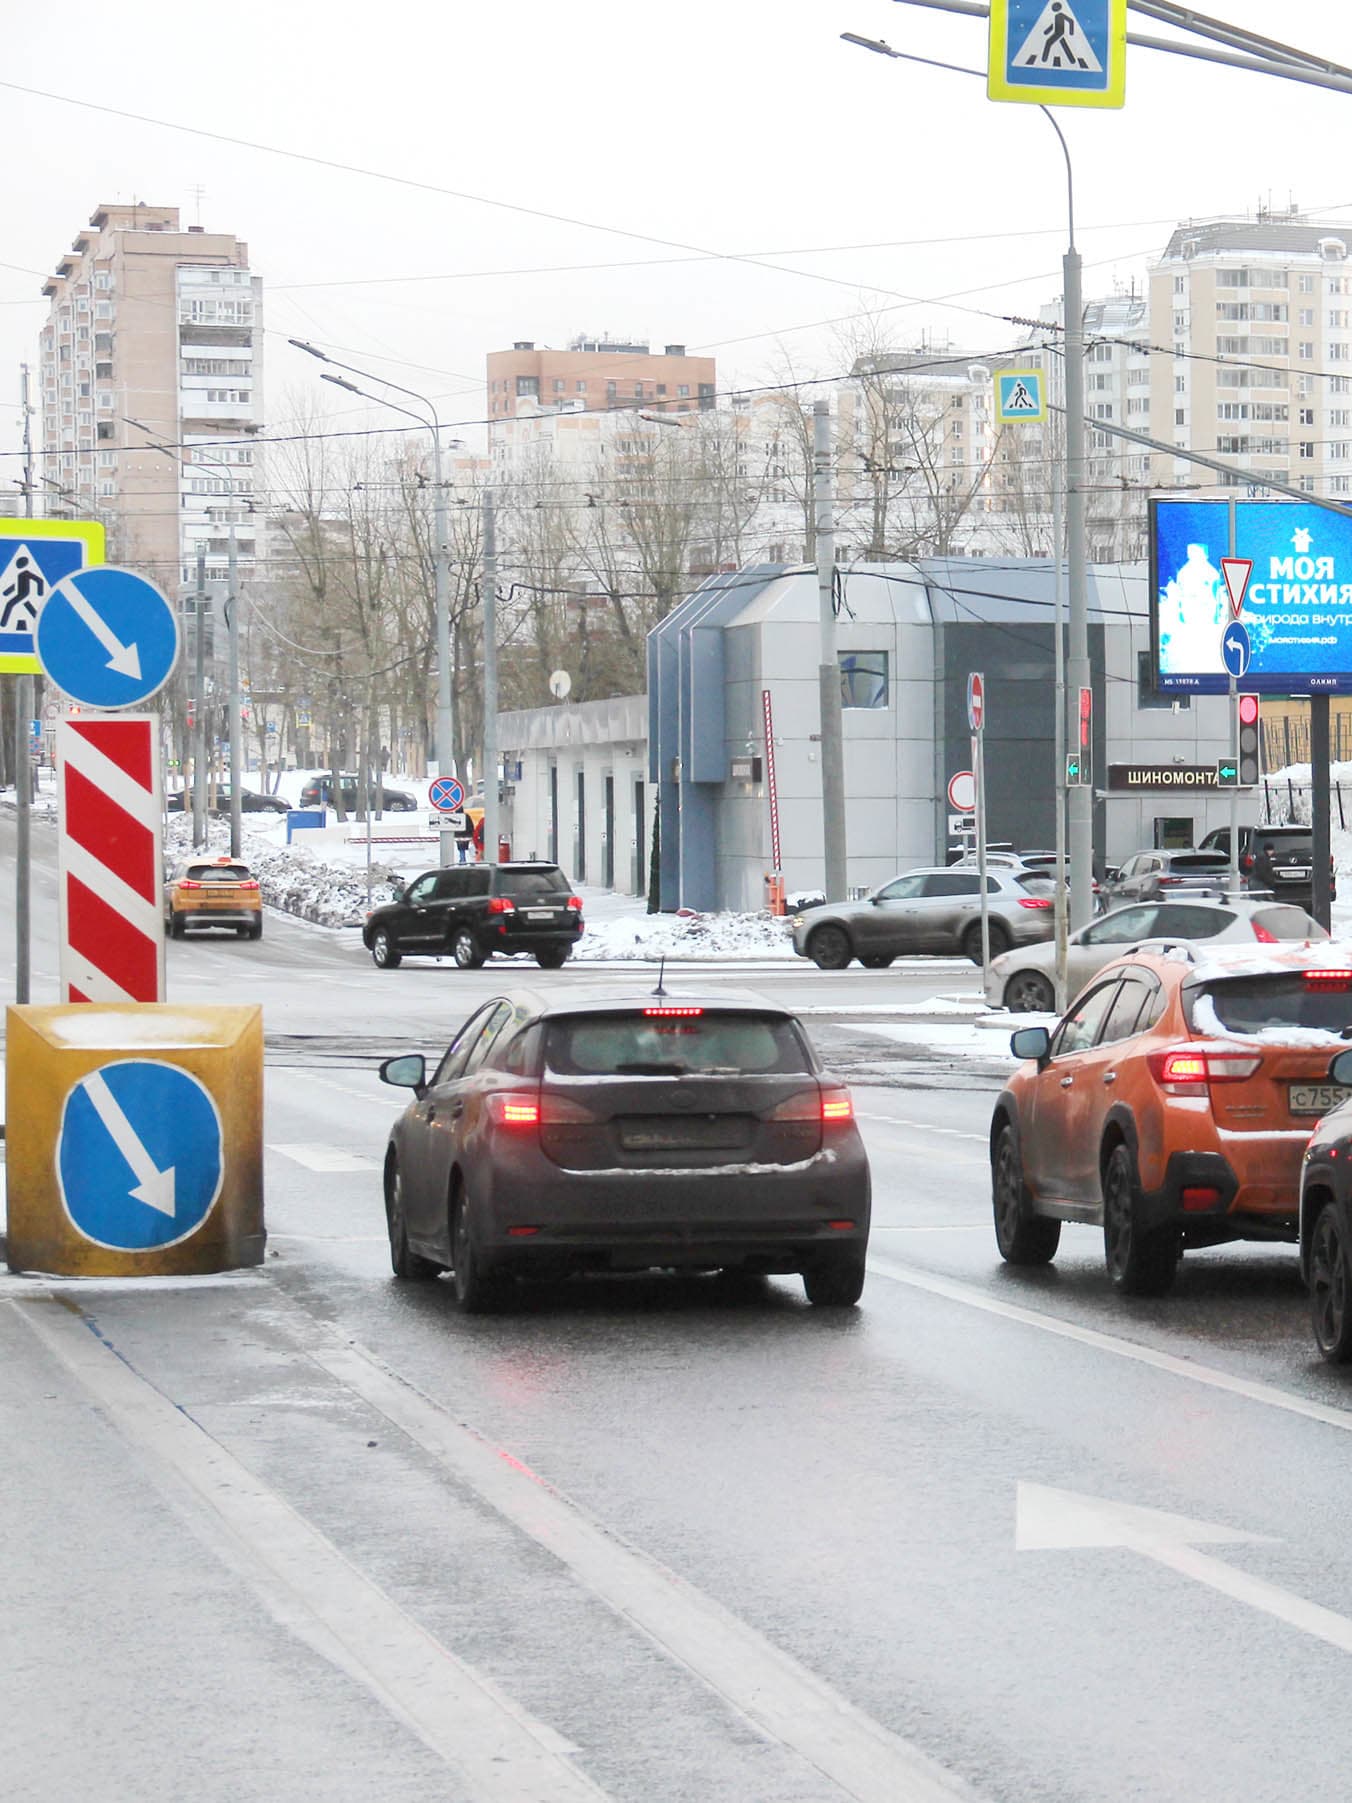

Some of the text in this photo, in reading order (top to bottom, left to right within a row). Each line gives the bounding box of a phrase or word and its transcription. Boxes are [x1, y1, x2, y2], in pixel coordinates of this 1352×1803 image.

[1270, 556, 1335, 580] МОЯ
[1248, 613, 1309, 626] рирода
[1128, 771, 1219, 785] ШИНОМОНТА
